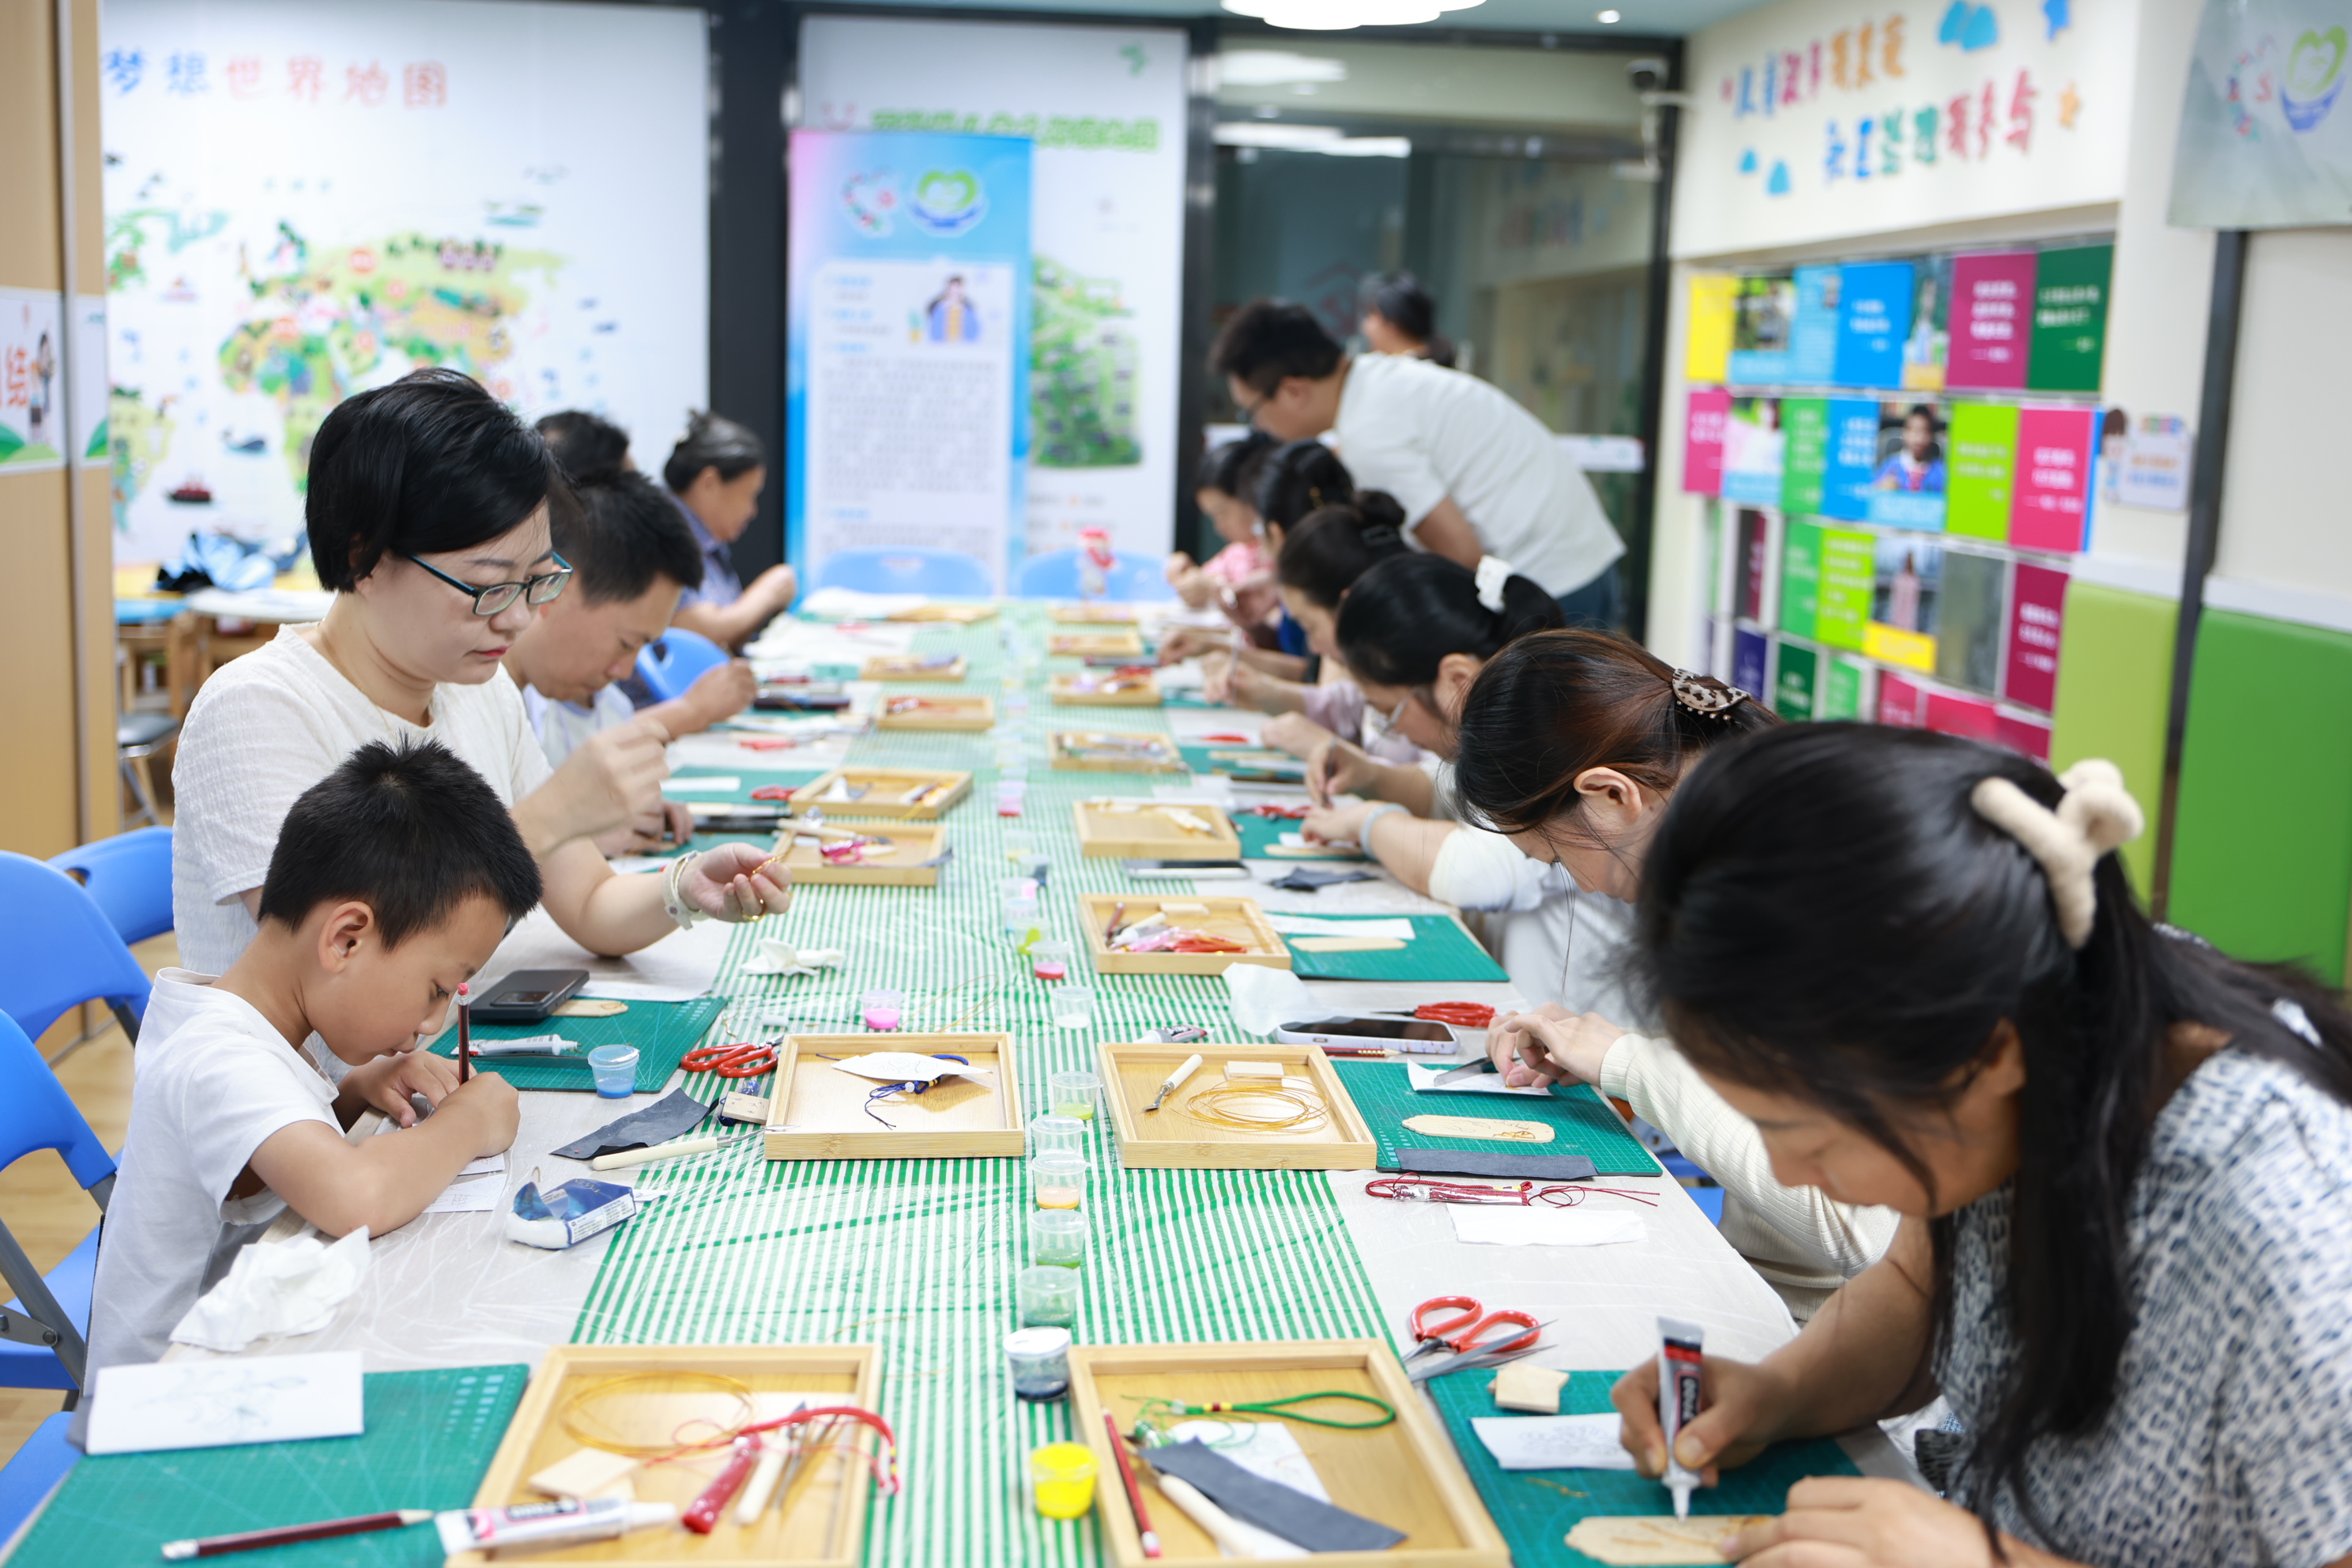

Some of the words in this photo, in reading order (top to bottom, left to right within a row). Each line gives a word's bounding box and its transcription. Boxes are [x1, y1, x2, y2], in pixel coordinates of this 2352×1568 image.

[104, 47, 447, 107] 梦想世界地图
